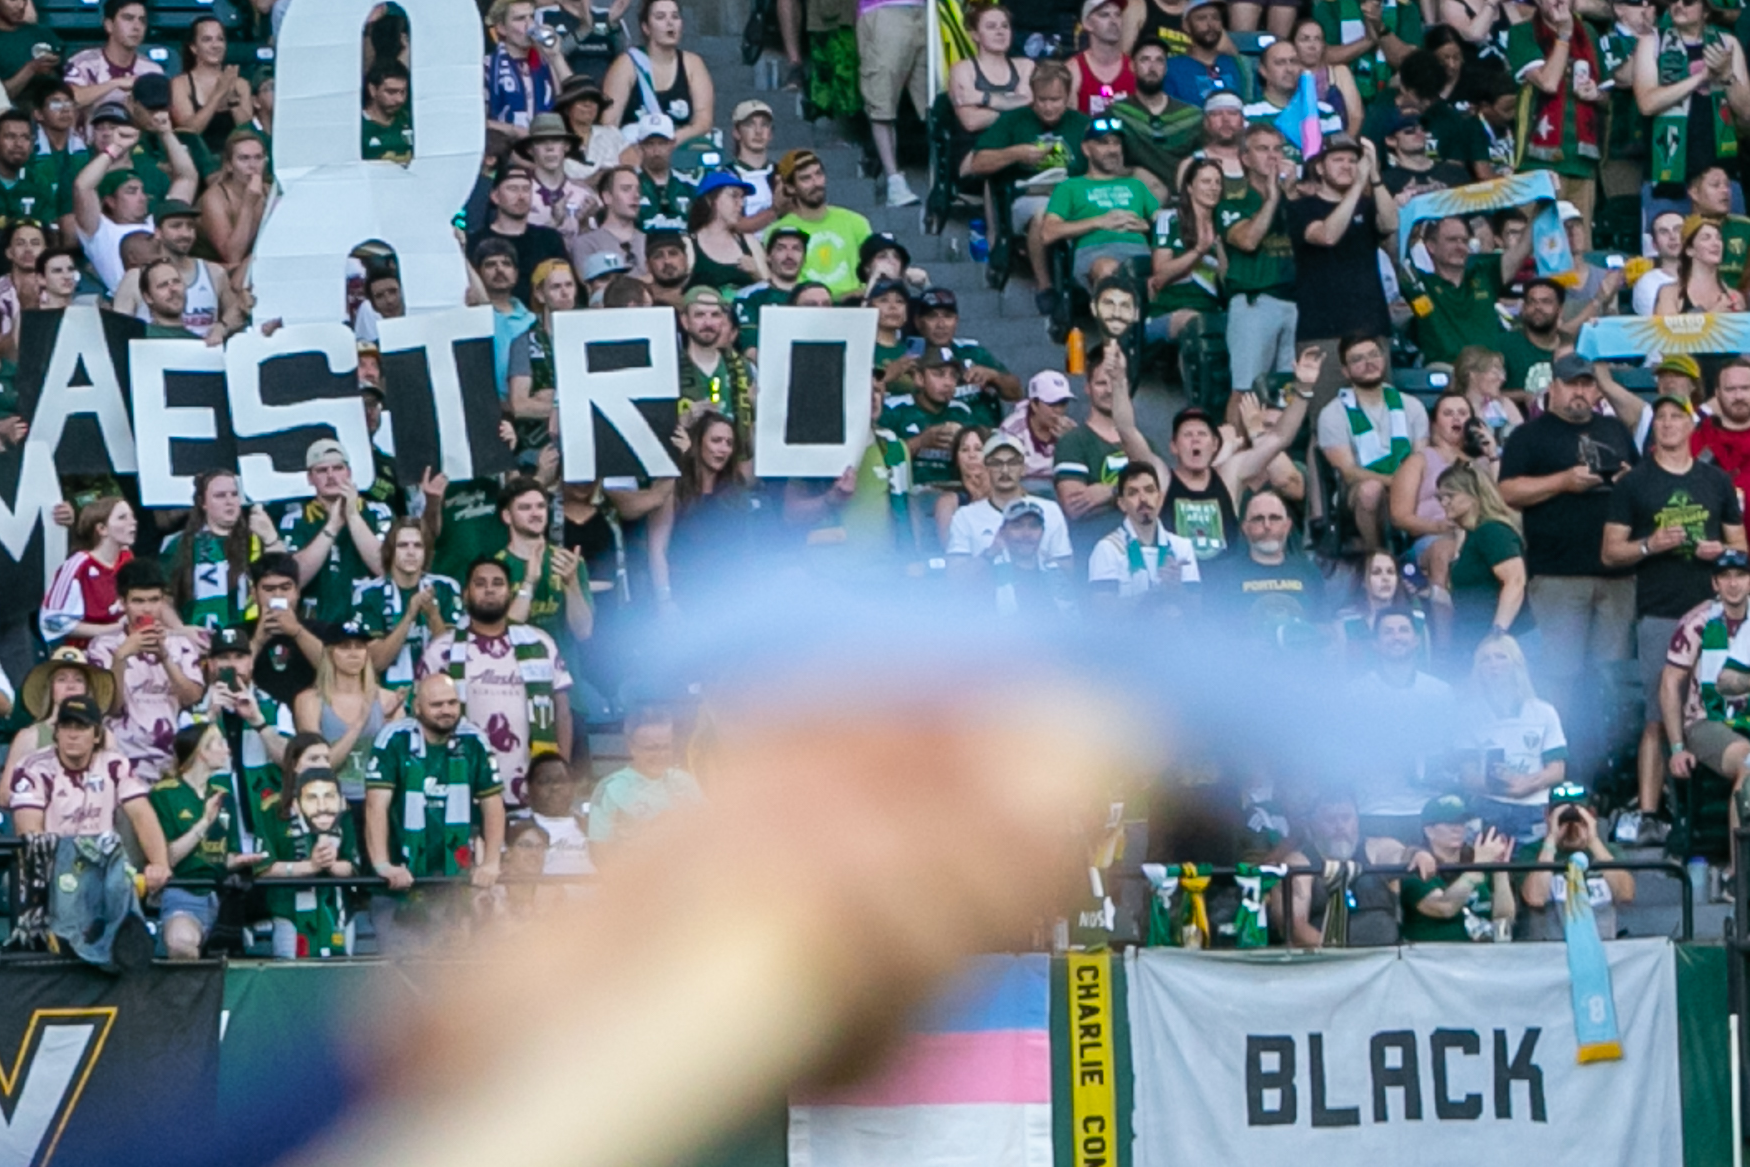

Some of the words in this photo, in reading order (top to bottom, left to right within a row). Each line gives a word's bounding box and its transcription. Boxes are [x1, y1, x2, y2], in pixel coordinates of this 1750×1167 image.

[1242, 580, 1304, 593] PORTLAND
[1076, 965, 1104, 1086] CHARLIE
[1246, 1026, 1547, 1127] BLACK
